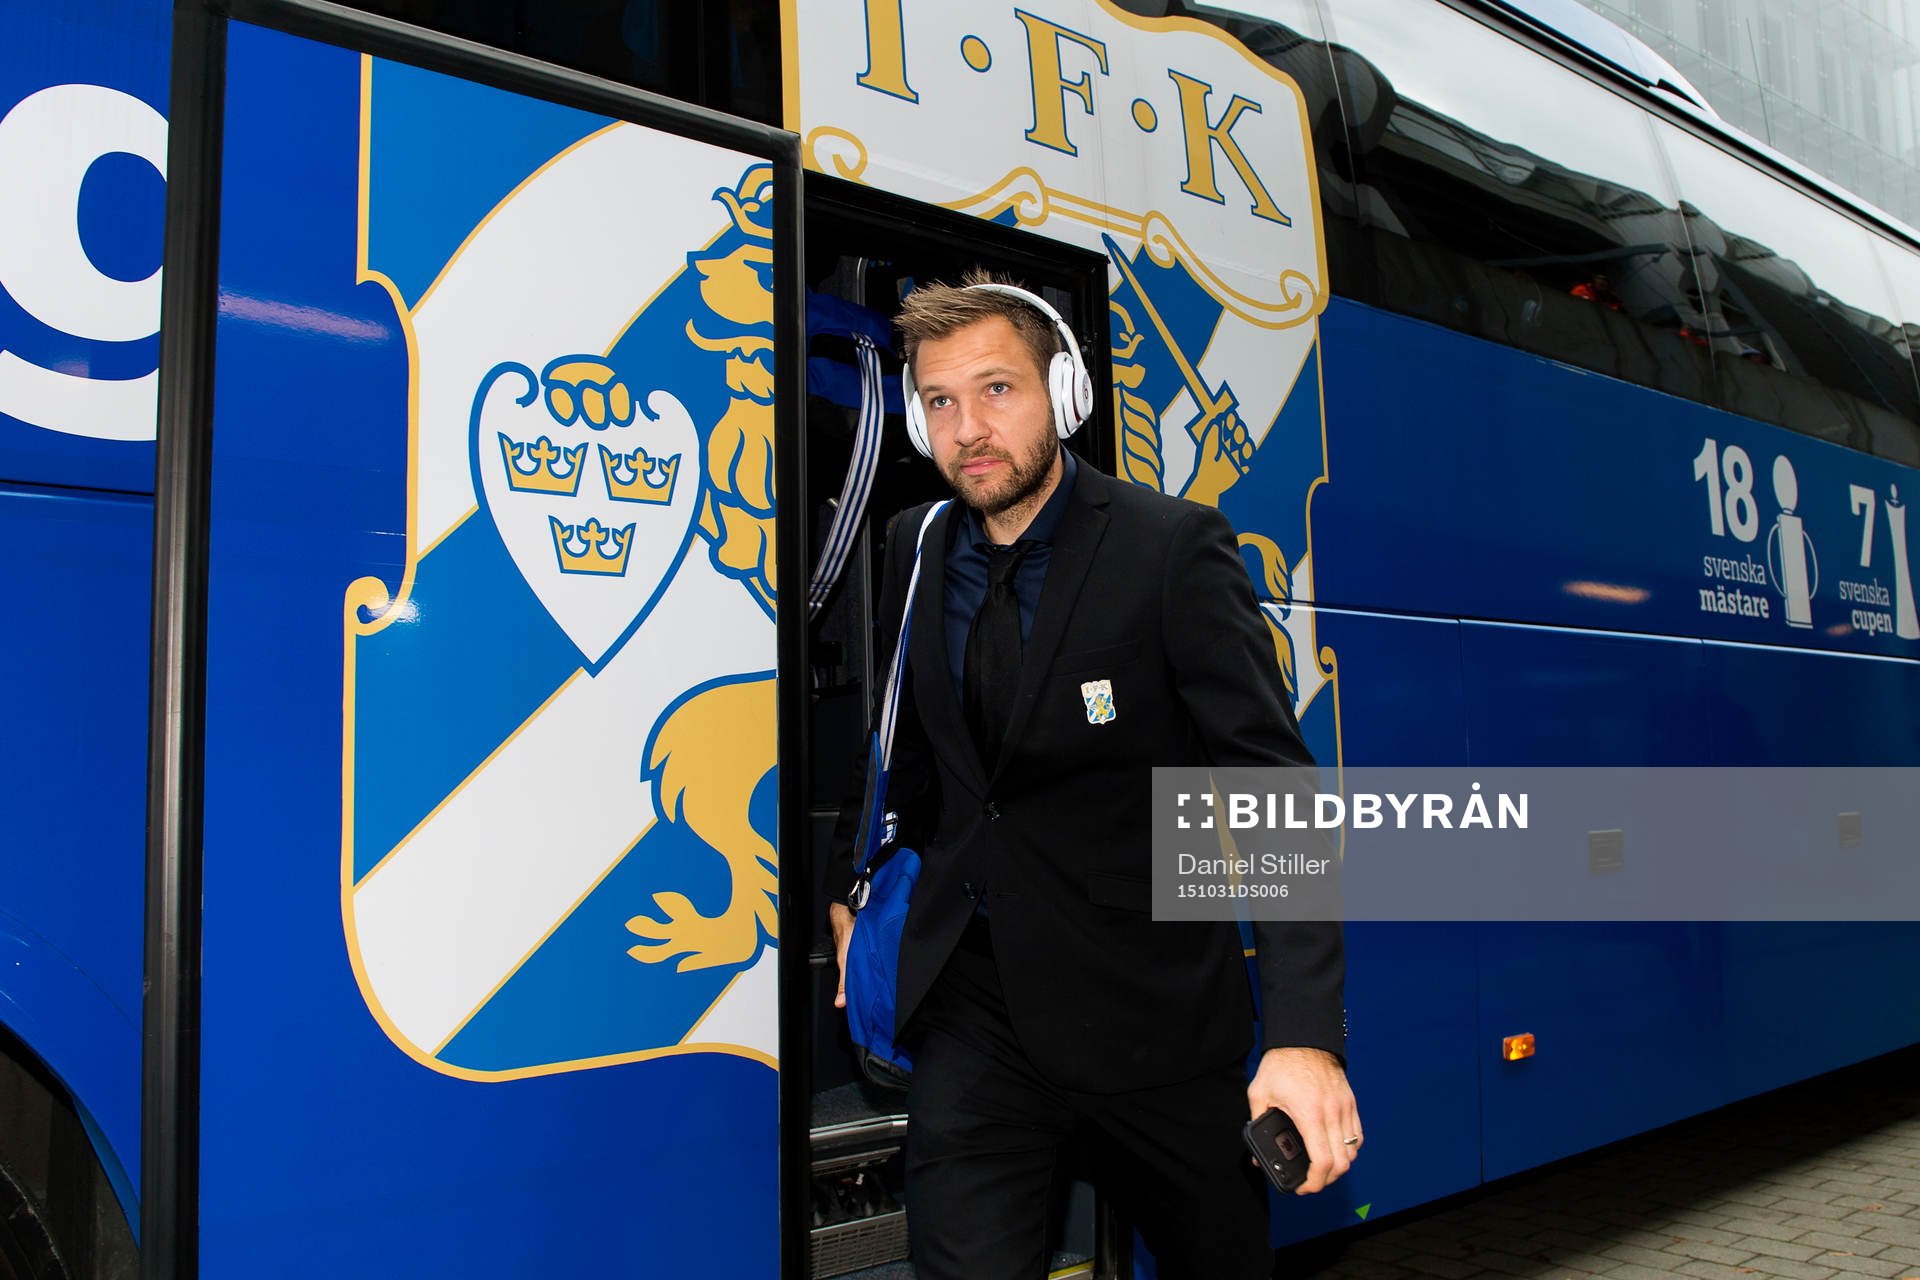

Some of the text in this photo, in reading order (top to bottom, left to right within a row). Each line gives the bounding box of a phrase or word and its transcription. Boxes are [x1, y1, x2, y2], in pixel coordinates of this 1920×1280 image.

[1693, 438, 1758, 542] 18
[1849, 484, 1875, 568] 7
[1704, 554, 1767, 585] svenska
[1699, 586, 1770, 618] mästare
[1839, 578, 1890, 606] svenska
[1851, 609, 1893, 636] cupen
